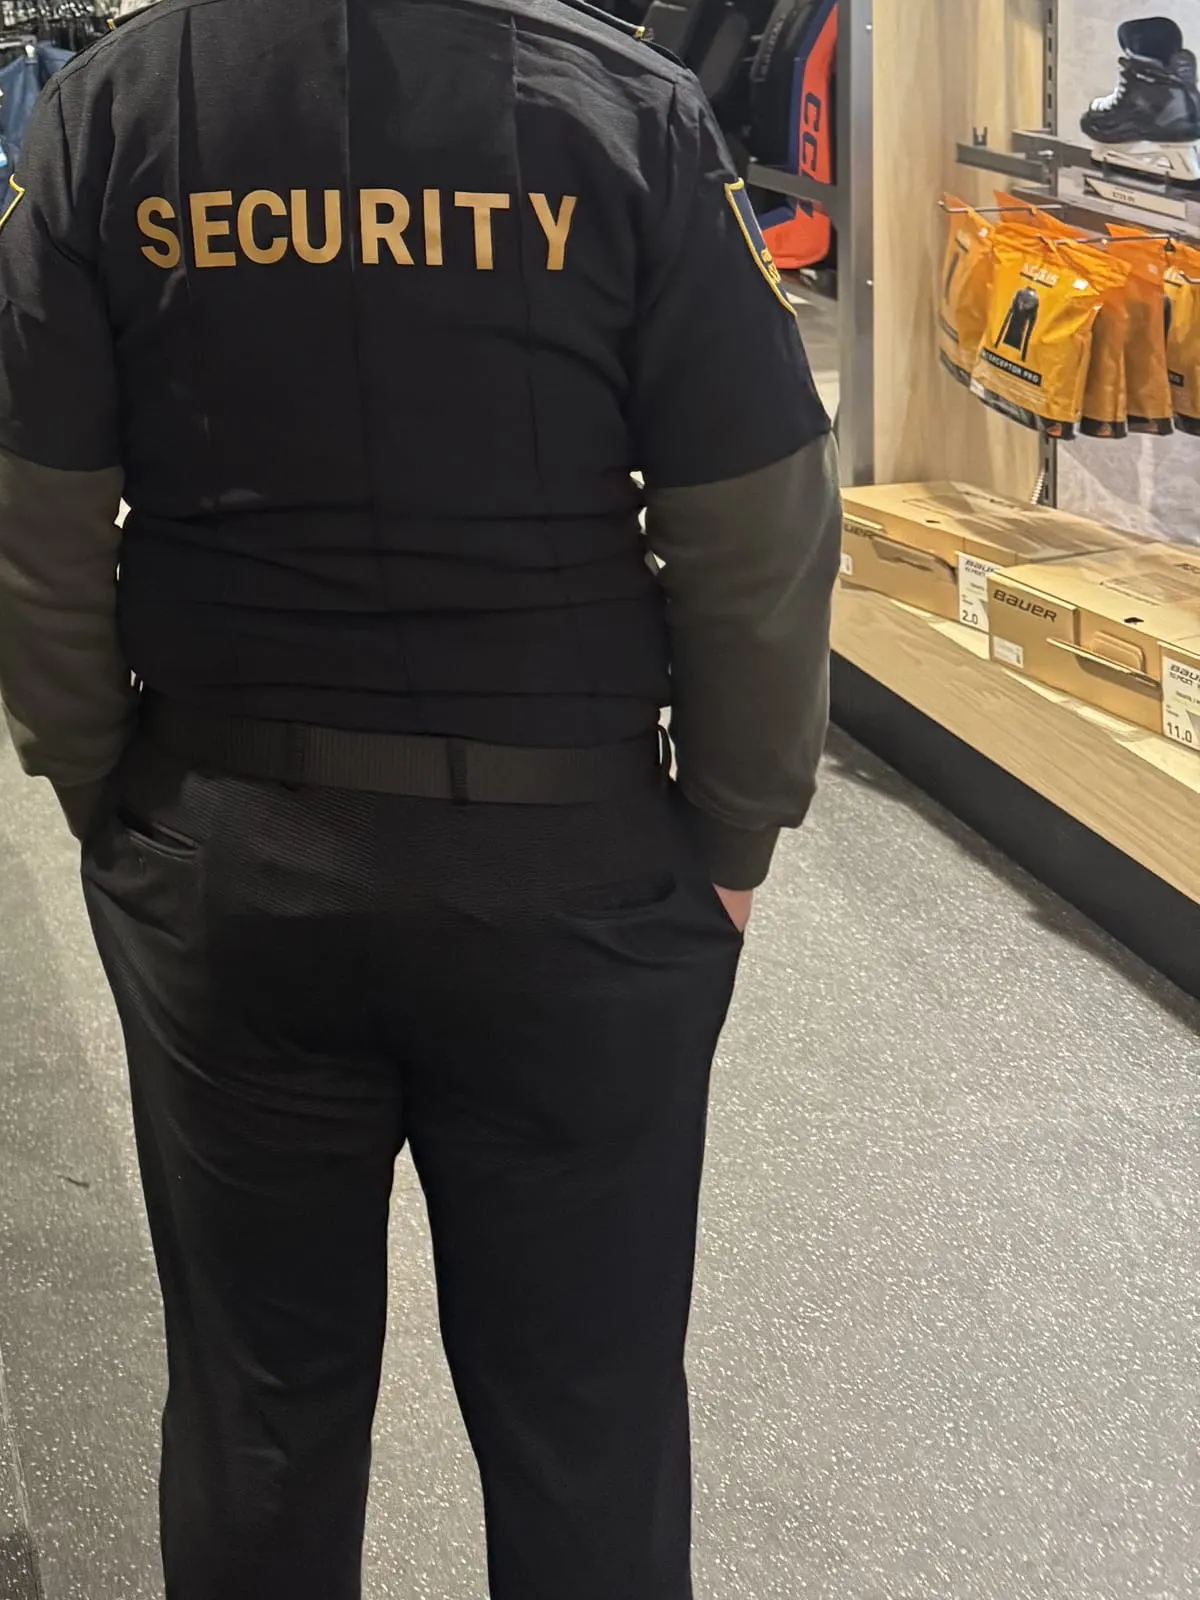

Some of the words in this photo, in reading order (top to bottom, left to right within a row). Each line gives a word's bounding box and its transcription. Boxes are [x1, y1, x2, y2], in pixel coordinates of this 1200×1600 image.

[136, 188, 577, 271] SECURITY
[993, 589, 1057, 623] BAUER
[962, 609, 979, 626] 2.0
[1170, 663, 1200, 682] BAU
[1167, 722, 1193, 744] 11.0
